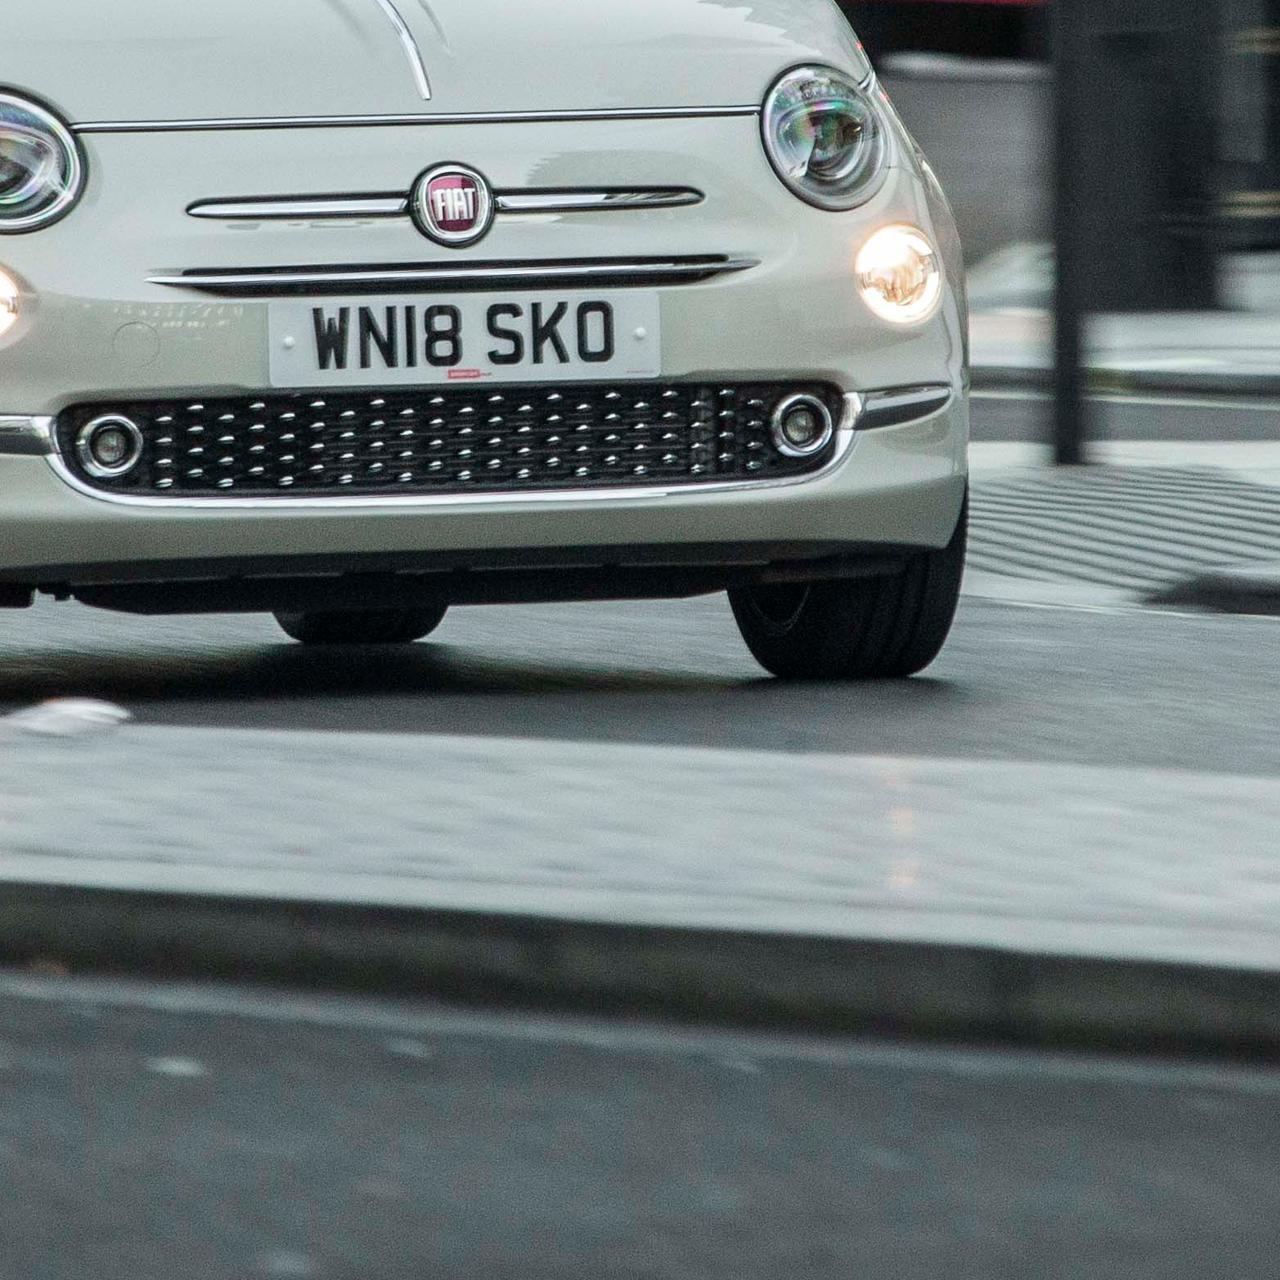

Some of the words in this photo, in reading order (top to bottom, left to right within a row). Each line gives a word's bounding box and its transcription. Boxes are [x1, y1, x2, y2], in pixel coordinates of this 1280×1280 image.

[433, 187, 476, 221] FIAT
[312, 304, 463, 370] WN18
[486, 300, 615, 365] SKO
